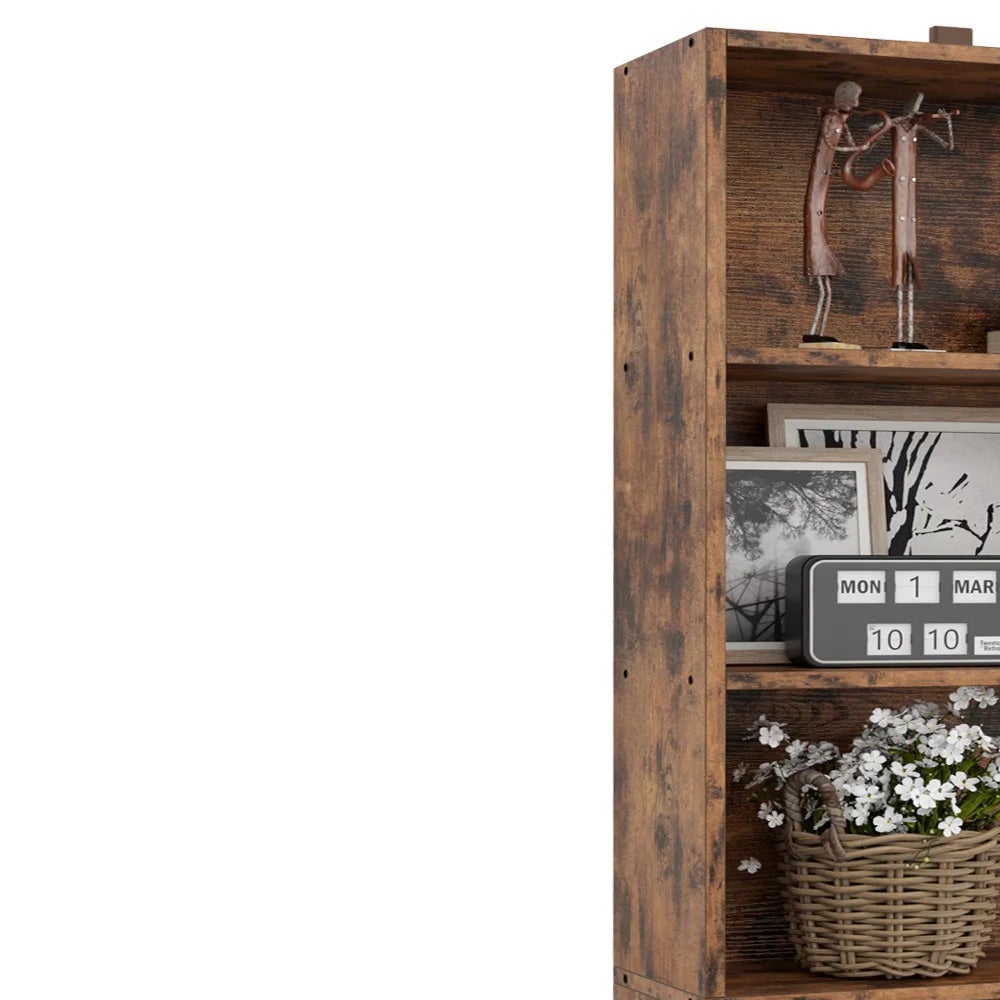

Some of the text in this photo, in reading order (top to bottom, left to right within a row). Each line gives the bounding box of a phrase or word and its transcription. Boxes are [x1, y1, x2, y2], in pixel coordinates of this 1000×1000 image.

[840, 576, 995, 598] MON 1 MAR
[872, 629, 959, 650] 10 10
